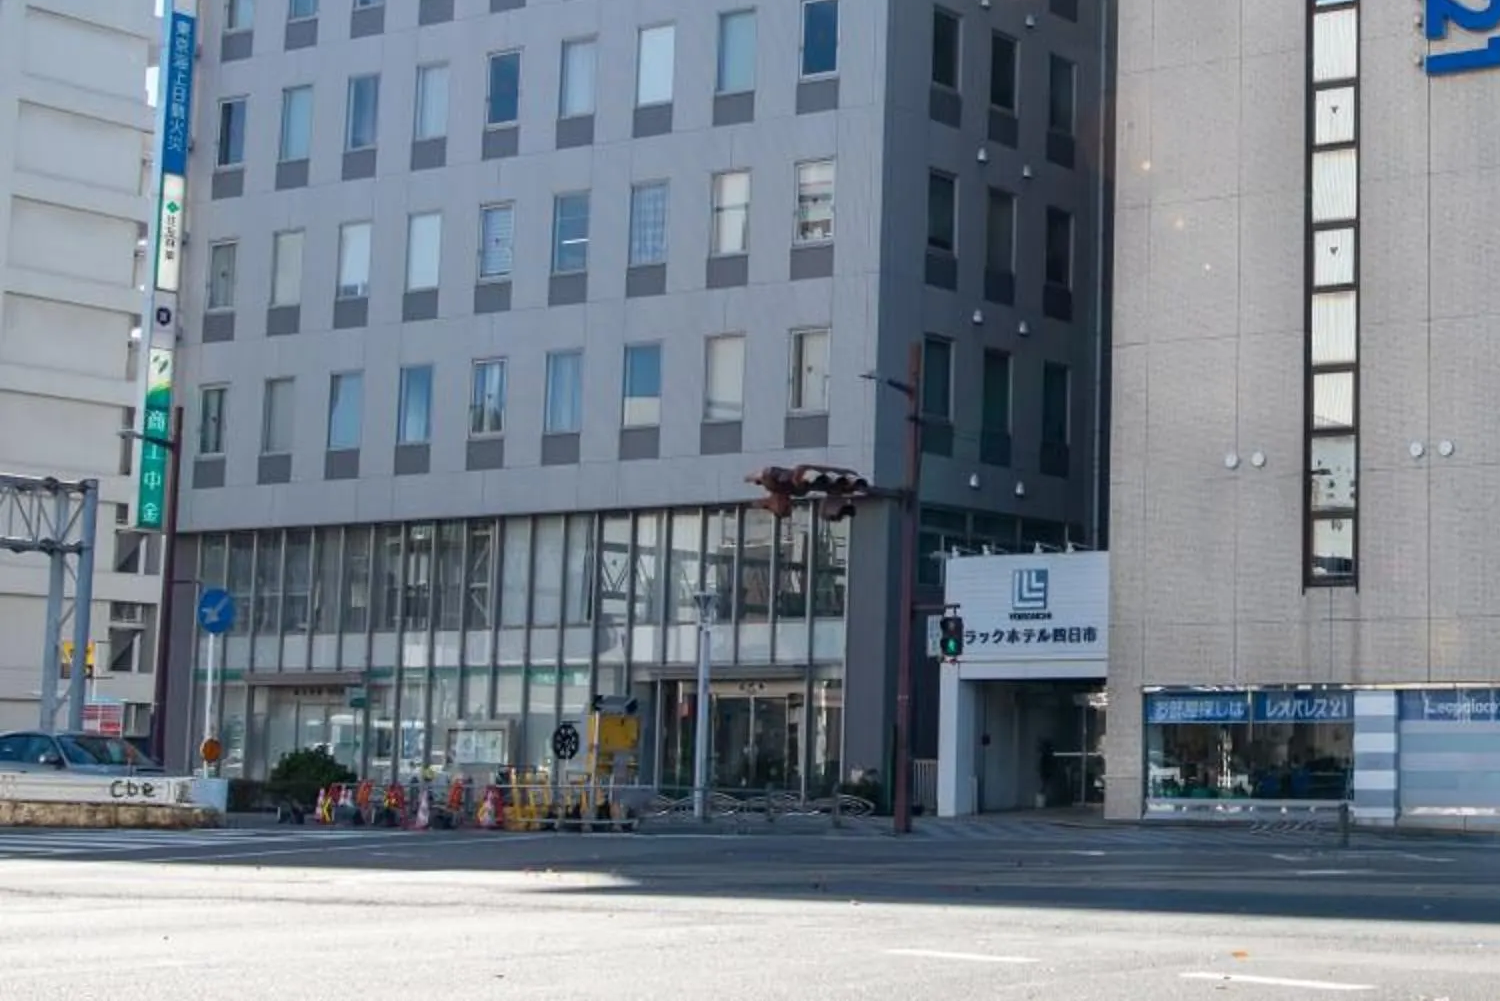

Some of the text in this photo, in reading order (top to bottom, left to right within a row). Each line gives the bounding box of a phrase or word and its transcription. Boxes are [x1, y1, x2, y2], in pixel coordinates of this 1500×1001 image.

[142, 409, 166, 522] 商工中金
[964, 626, 1098, 644] ラックホテル四日市
